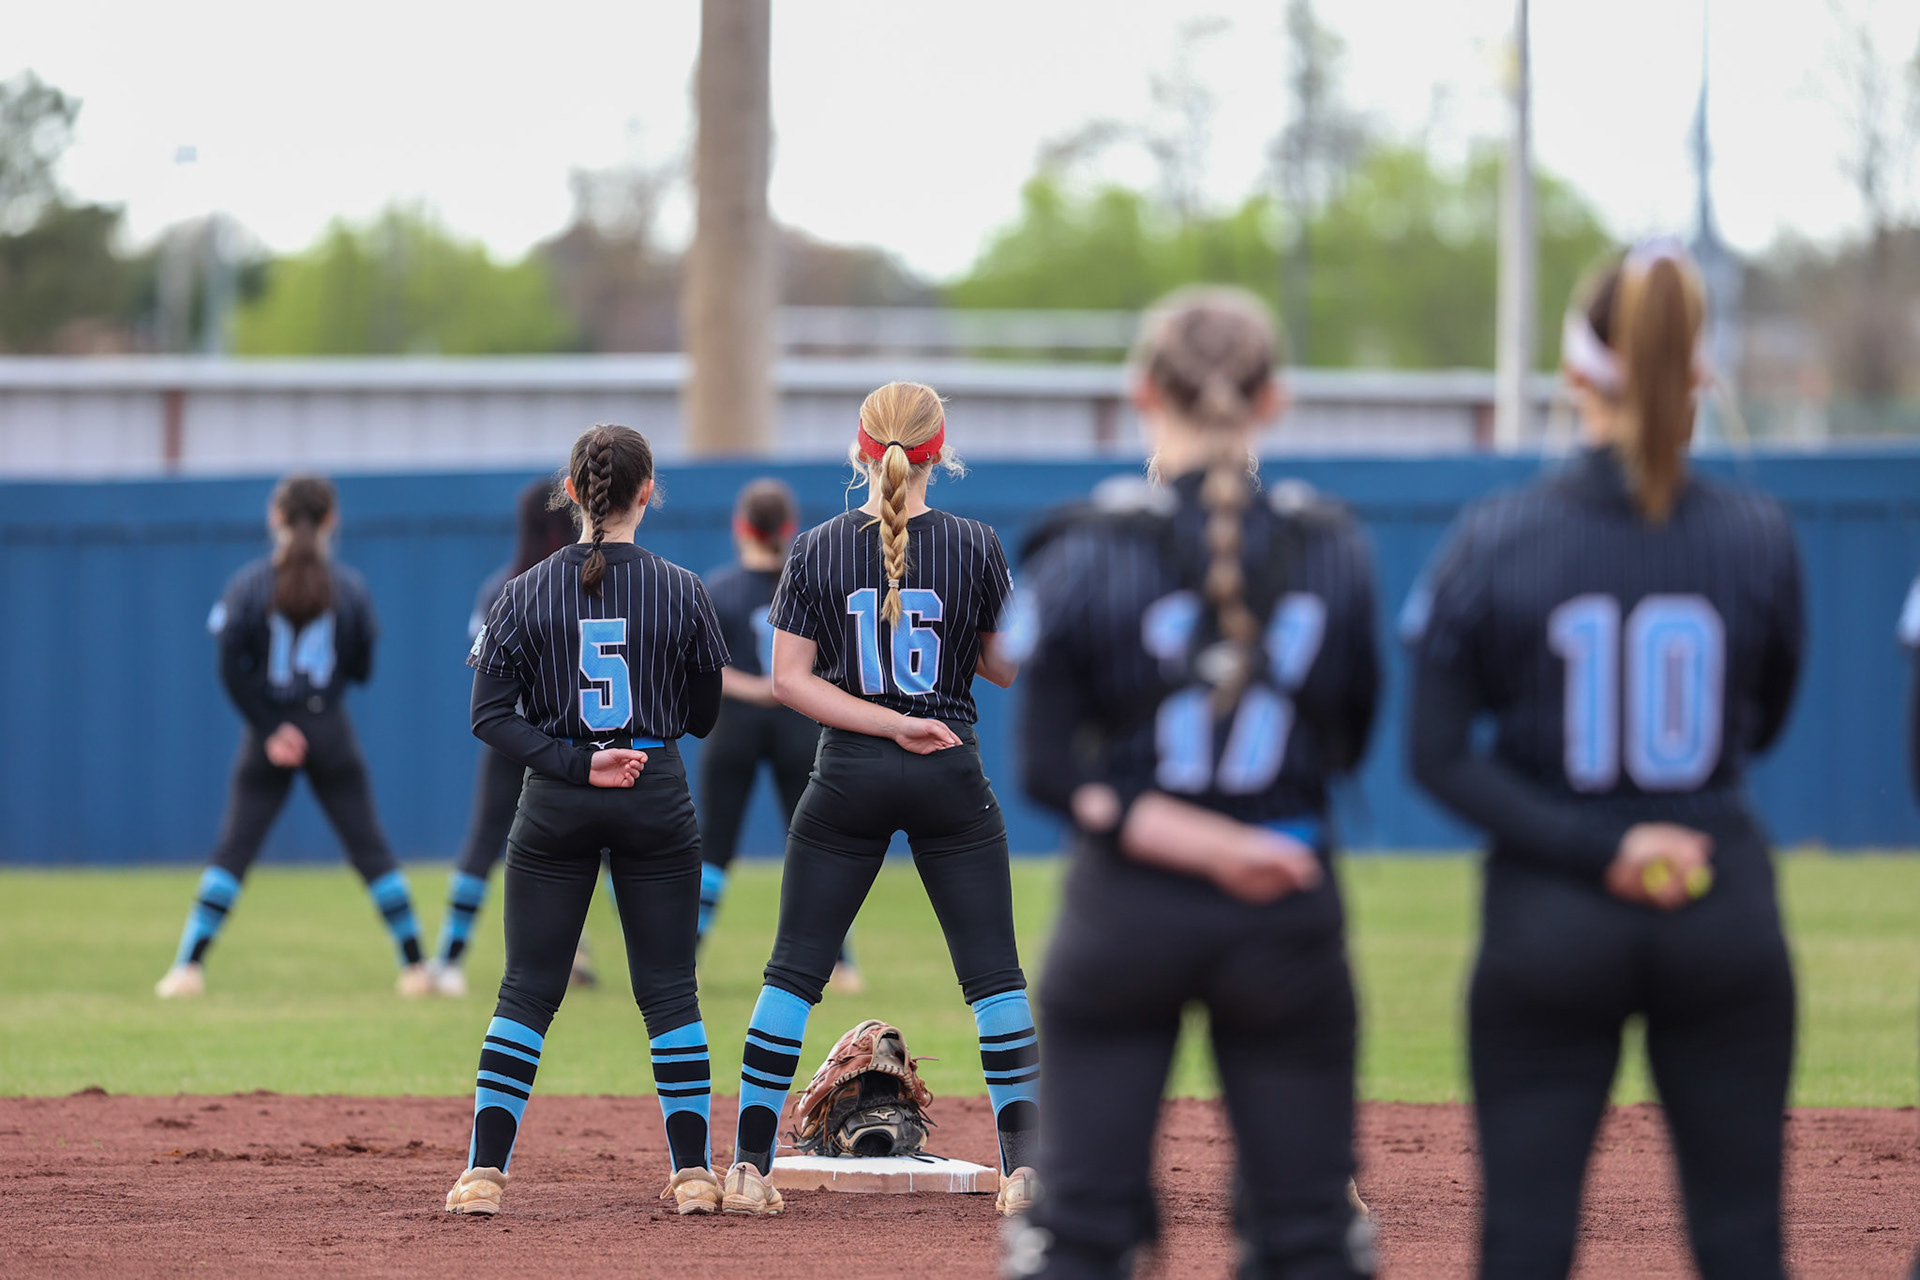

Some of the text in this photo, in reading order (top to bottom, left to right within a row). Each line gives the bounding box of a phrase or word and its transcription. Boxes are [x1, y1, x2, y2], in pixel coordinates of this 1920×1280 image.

[579, 618, 633, 731] 5
[847, 588, 943, 695] 16
[1547, 593, 1726, 793] 10
